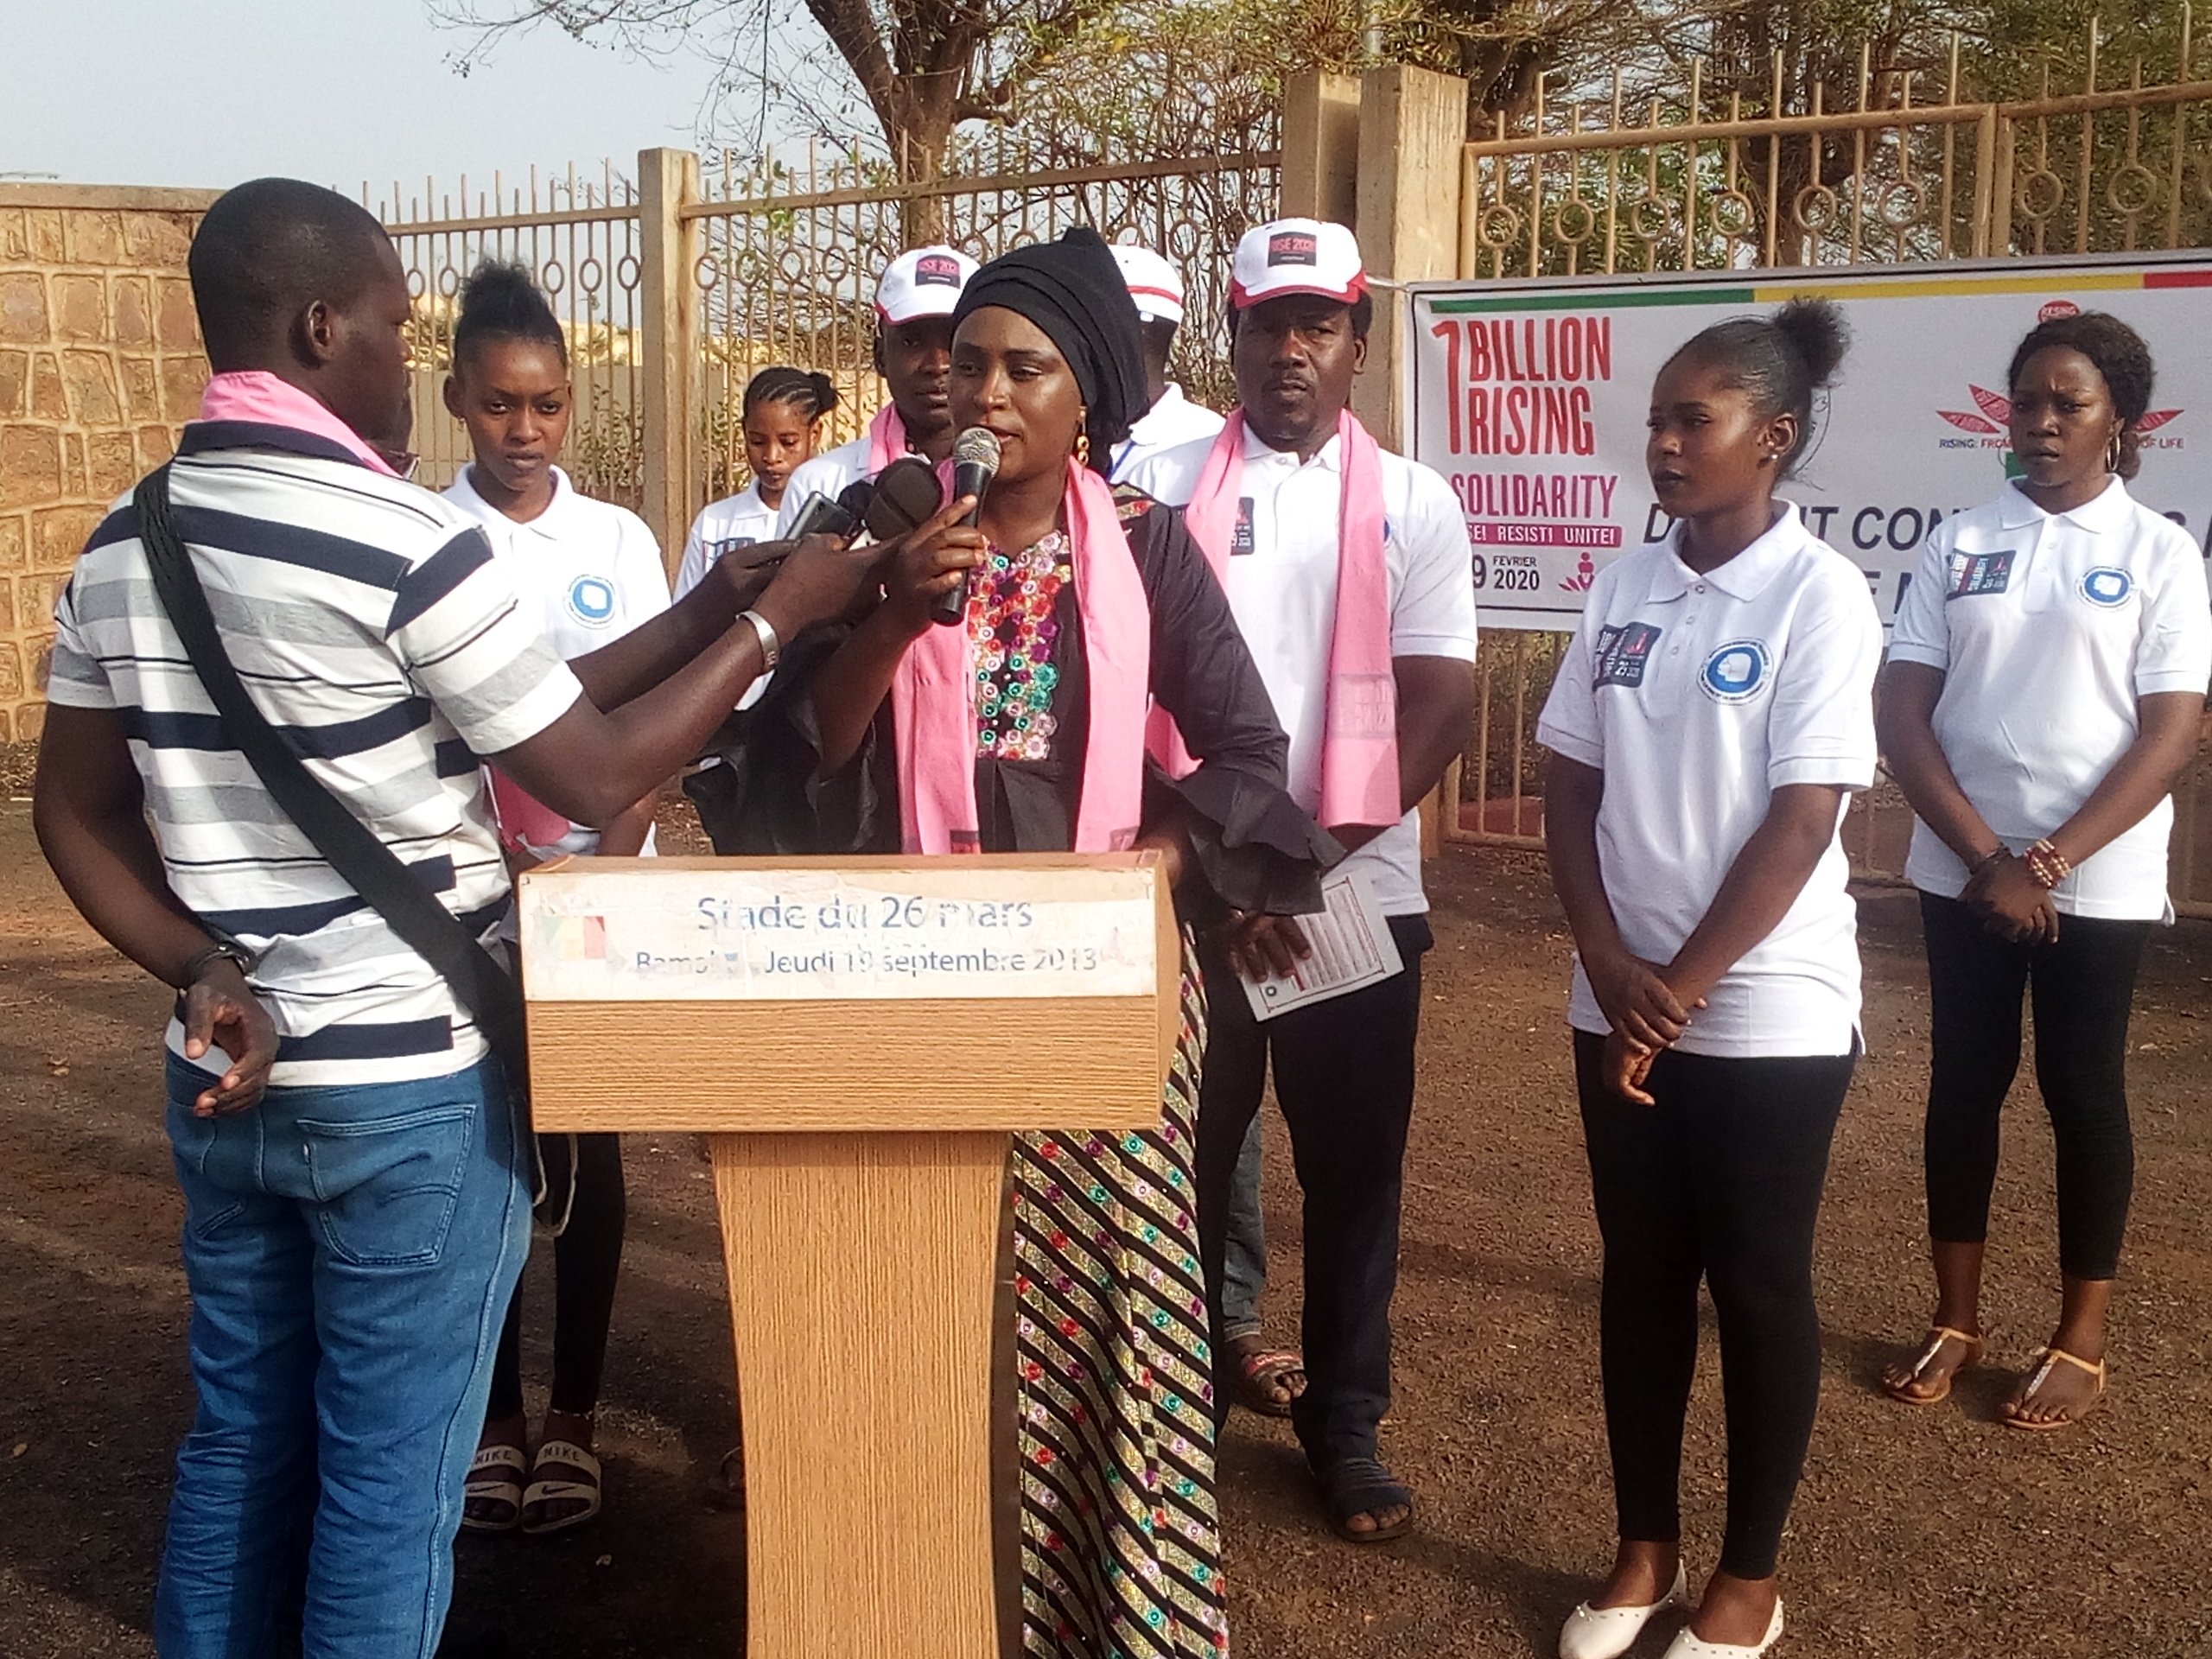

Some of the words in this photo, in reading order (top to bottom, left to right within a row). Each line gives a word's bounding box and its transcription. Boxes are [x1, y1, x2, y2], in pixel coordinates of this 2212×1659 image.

[1431, 320, 1460, 455] 1
[1467, 316, 1611, 382] BILLION
[1468, 385, 1594, 456] RISING
[1451, 473, 1618, 518] SOLIDARITY
[1497, 524, 1554, 543] RESIST!
[1563, 526, 1615, 544] UNITE!
[1493, 569, 1540, 591] 2020
[880, 895, 926, 929] 26
[765, 950, 834, 974] Jeudi
[474, 1449, 512, 1465] NIKE
[543, 1445, 581, 1462] NIKE
